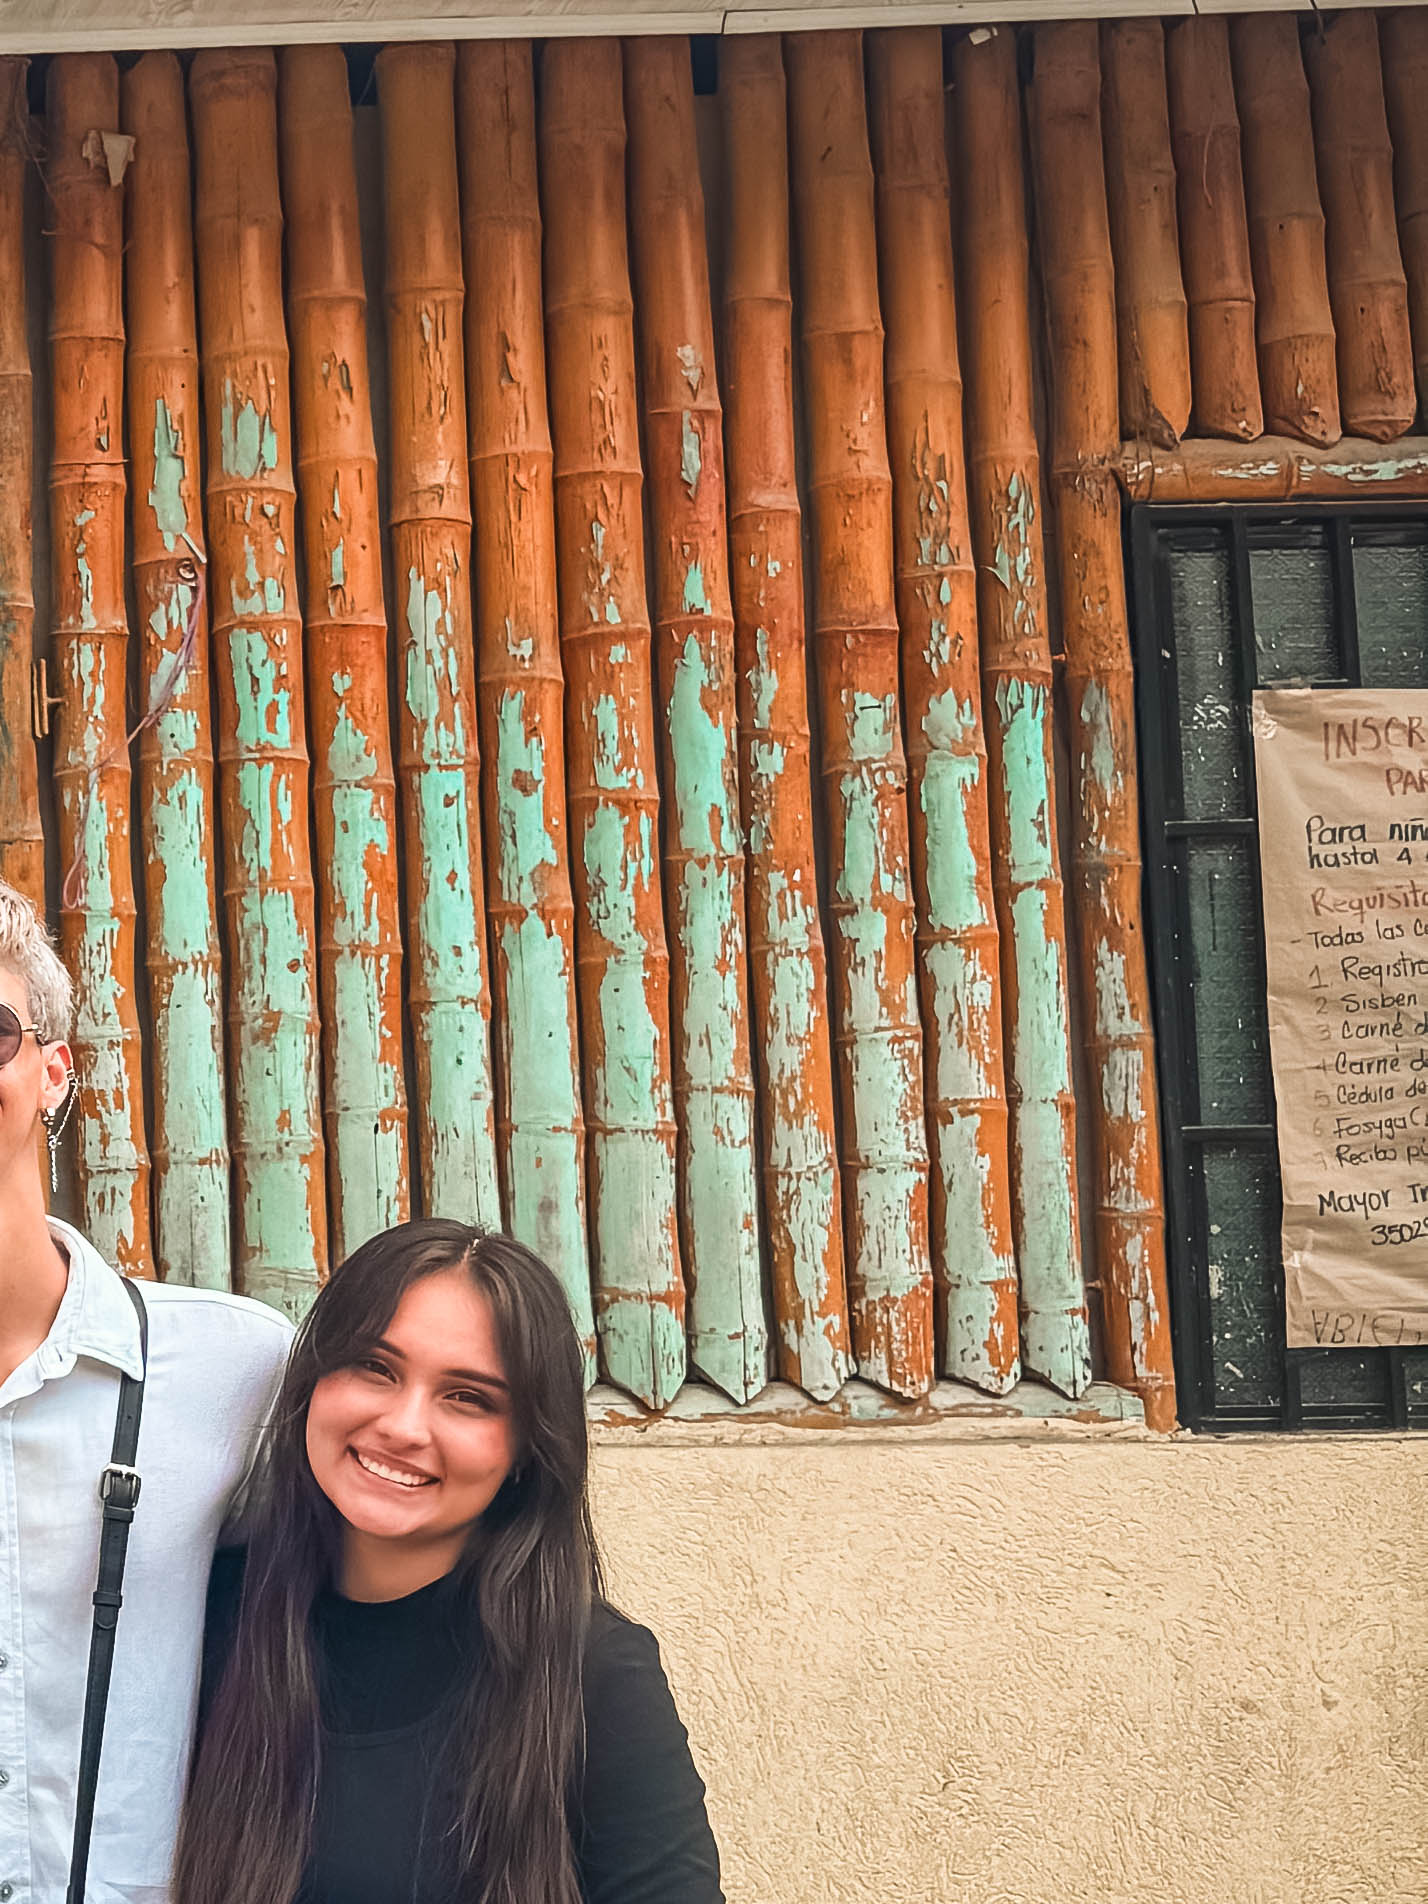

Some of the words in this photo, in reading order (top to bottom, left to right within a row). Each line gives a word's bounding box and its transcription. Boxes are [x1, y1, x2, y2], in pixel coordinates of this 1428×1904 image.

[1305, 815, 1367, 845] Para
[1396, 847, 1412, 865] 4
[1307, 925, 1364, 949] Todas
[1376, 919, 1405, 939] las
[1314, 997, 1328, 1014] 2
[1337, 1084, 1394, 1105] Cédula
[1335, 1144, 1397, 1168] Recibo
[1318, 1190, 1391, 1220] Mayor
